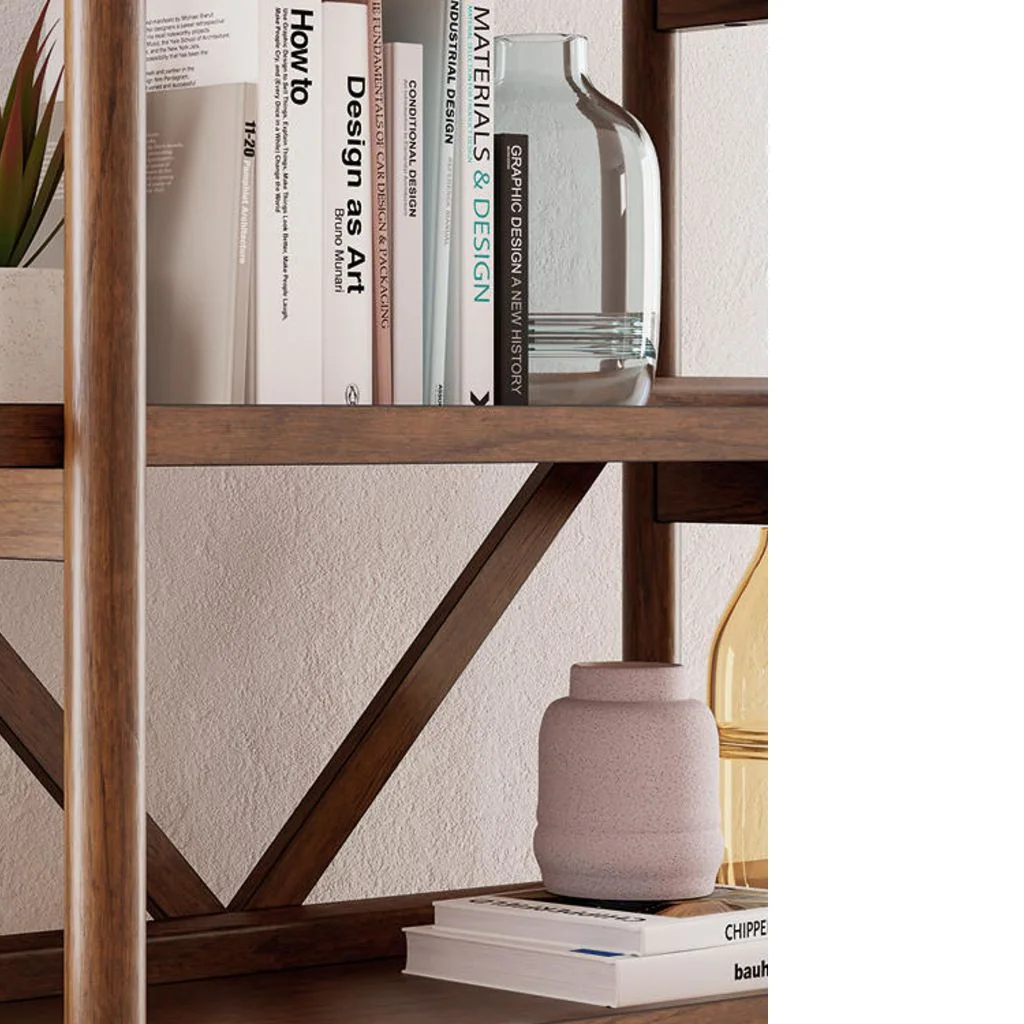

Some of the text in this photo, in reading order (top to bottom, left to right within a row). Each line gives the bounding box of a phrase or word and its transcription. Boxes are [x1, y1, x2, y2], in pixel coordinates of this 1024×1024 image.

[290, 9, 314, 105] How to
[373, 17, 384, 129] FUNDAMENTALS
[243, 121, 256, 157] 11-20
[376, 131, 384, 148] OF
[409, 80, 417, 218] CONDITIONAL DESIGN
[445, 88, 456, 144] DESIGN
[342, 76, 366, 294] Design as Art
[377, 152, 386, 180] CAR
[473, 6, 490, 303] MATERIALS & DESIGN
[377, 182, 387, 232] DESIGN
[378, 235, 387, 245] &
[335, 208, 345, 293] Bruno Munari
[510, 145, 522, 395] GRAPHIC DESIGN A NEW HISTORY
[379, 249, 390, 329] PACKAGING
[725, 920, 767, 941] CHIPPE
[734, 960, 768, 980] bauh
